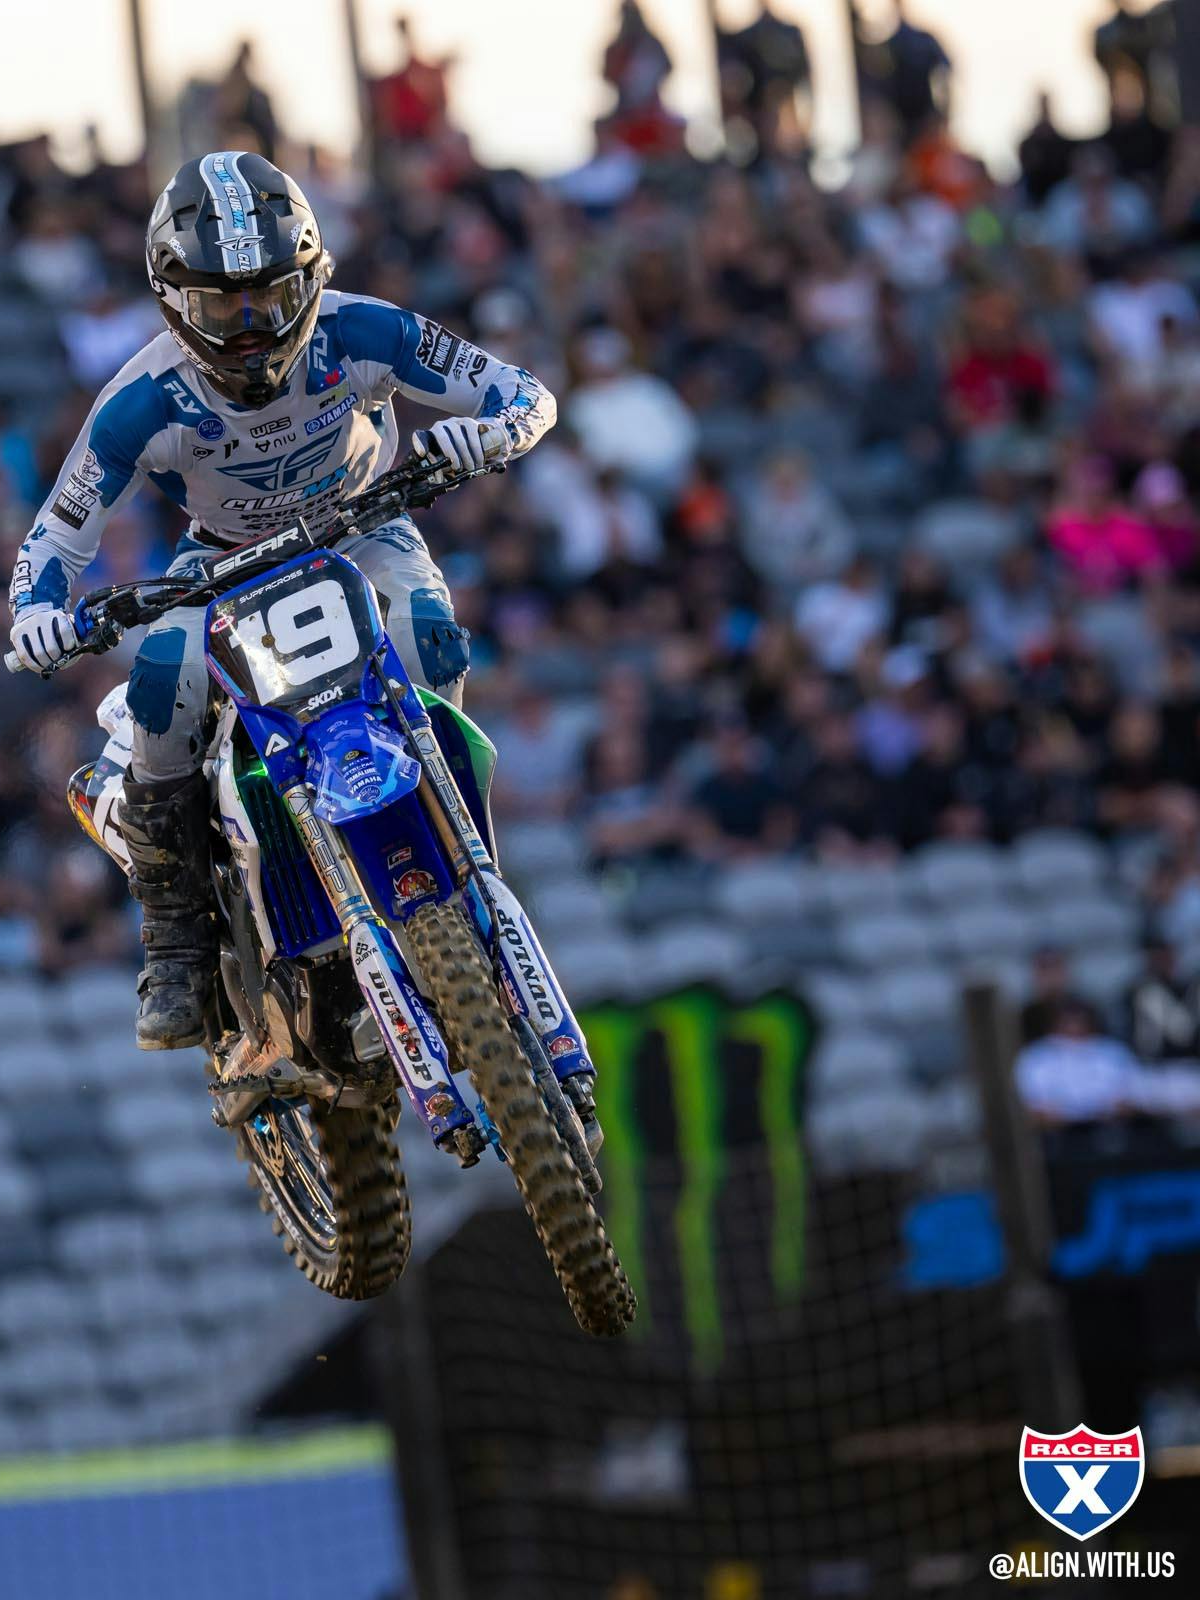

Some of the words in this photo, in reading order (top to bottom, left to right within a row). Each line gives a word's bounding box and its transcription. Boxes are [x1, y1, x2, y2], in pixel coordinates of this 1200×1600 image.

[224, 186, 247, 230] CLUBMX
[237, 252, 251, 272] CLU
[163, 380, 202, 414] FLY
[250, 416, 291, 438] WPS
[221, 457, 351, 511] CLUBMX
[213, 527, 300, 578] SCAR
[239, 568, 303, 605] SUPERCROSS
[228, 579, 359, 706] 19
[52, 654, 71, 671] ASV
[308, 685, 343, 711] SKDA
[350, 776, 383, 795] YAMAHA
[302, 815, 347, 893] REP
[355, 946, 379, 966] DUBYA
[497, 908, 558, 1021] DUNLOP
[402, 982, 442, 1053] ACERBIS
